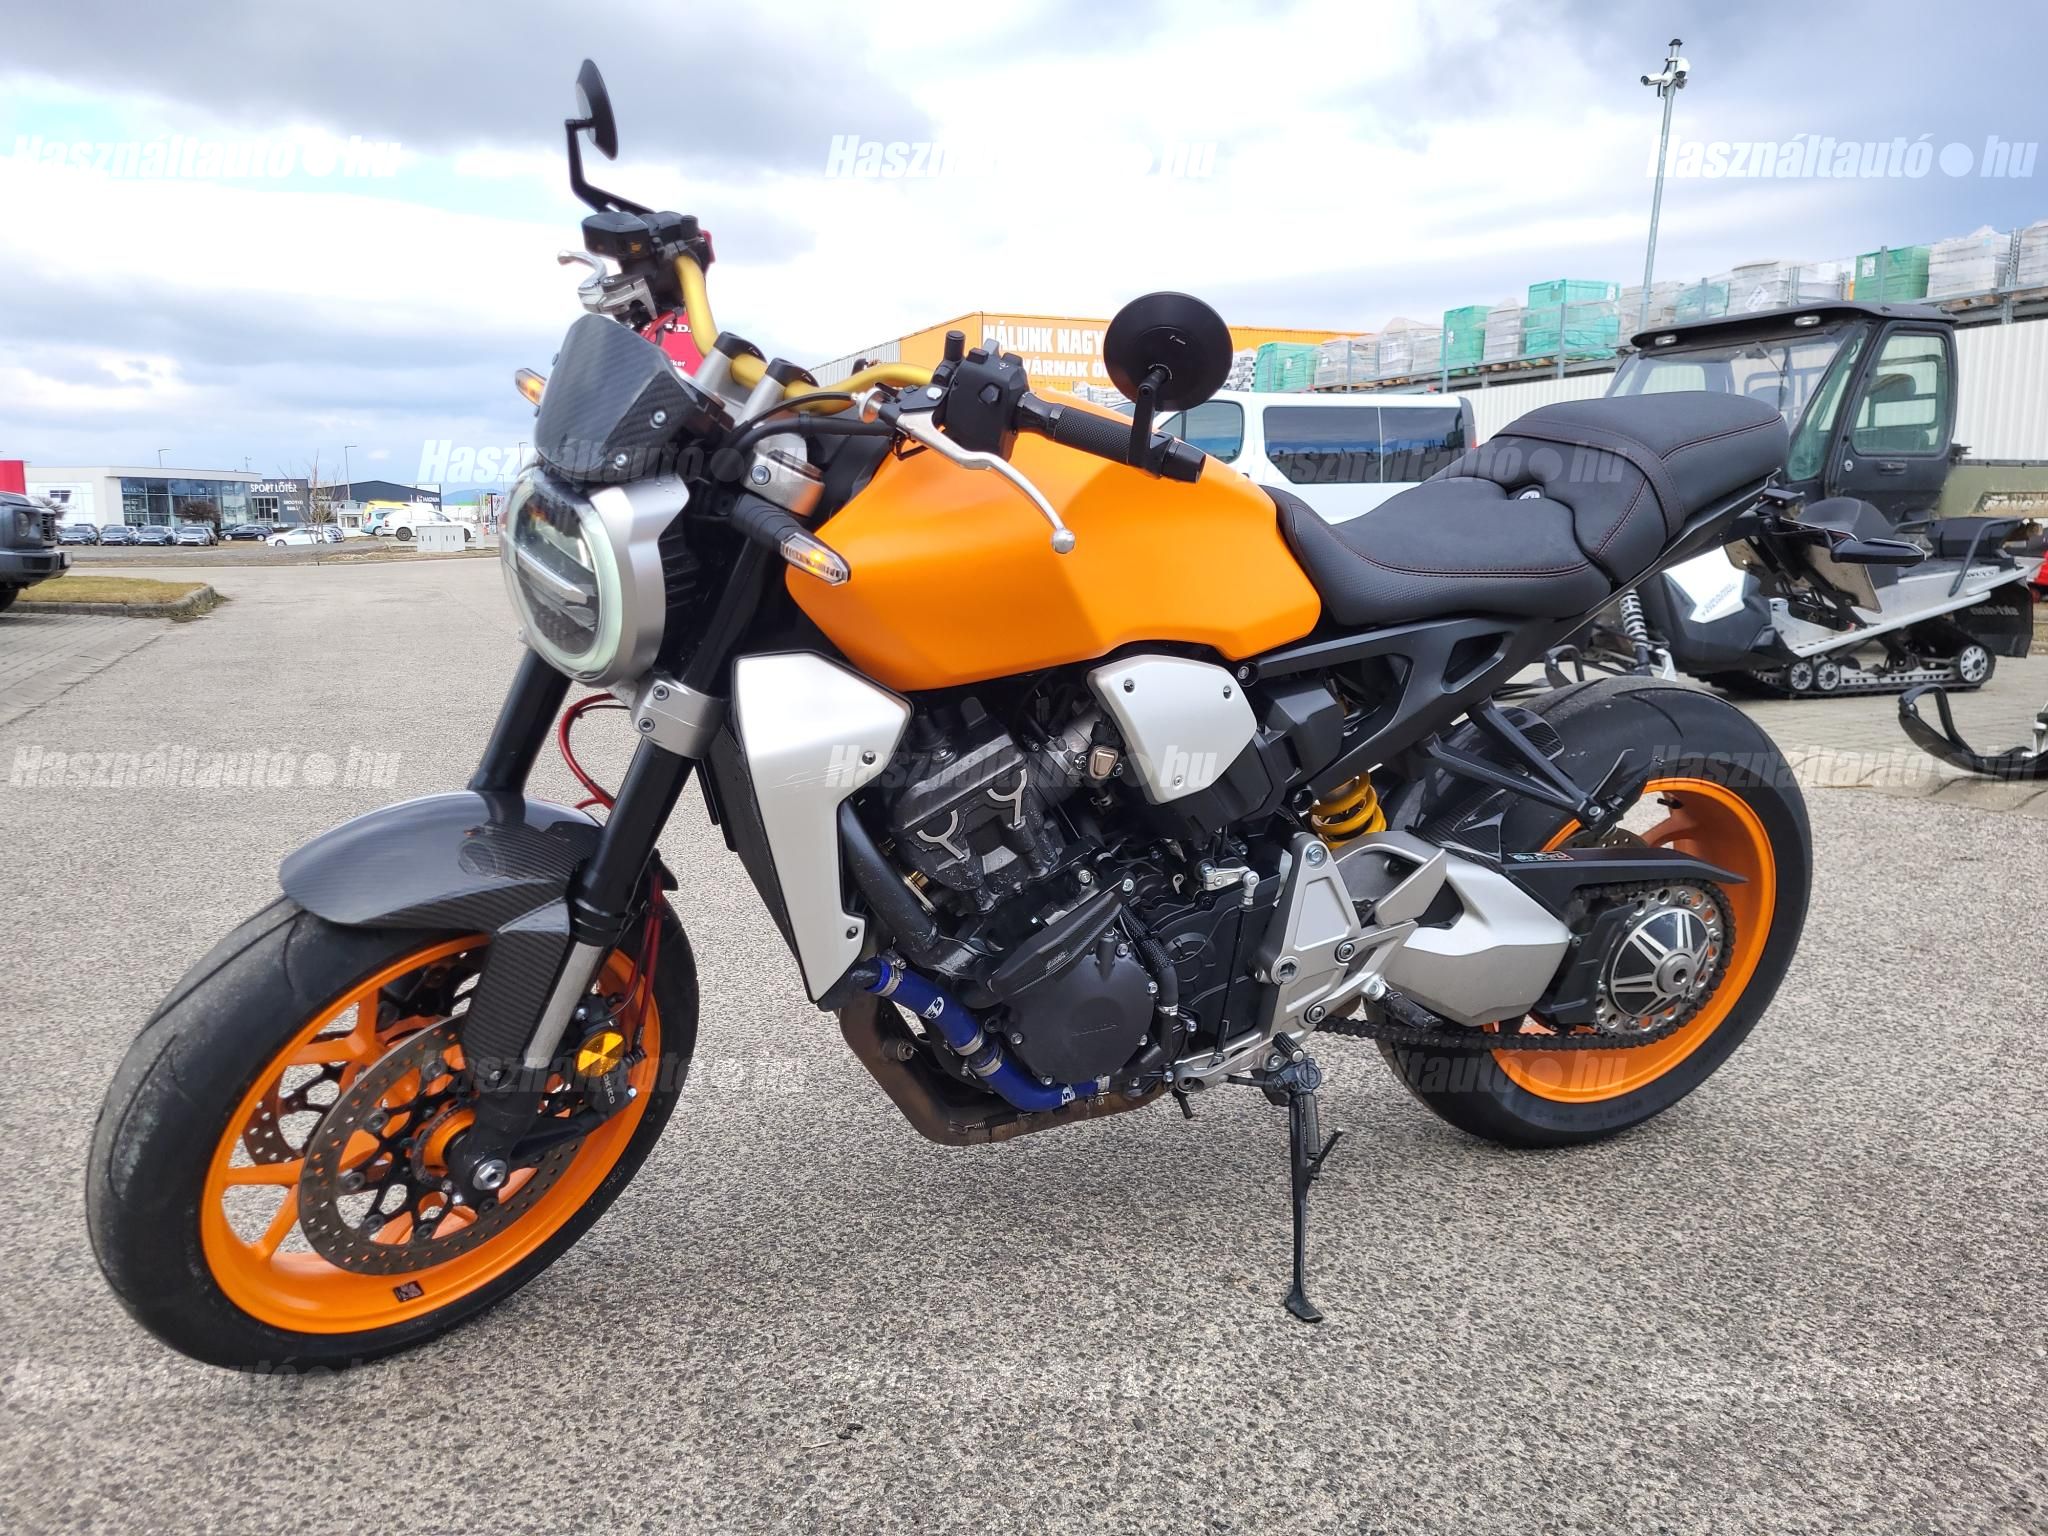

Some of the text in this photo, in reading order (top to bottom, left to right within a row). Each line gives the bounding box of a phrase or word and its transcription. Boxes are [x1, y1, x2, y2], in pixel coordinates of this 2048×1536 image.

[983, 320, 1054, 353] NÁLUNK
[1023, 356, 1089, 378] VÁRNAK
[250, 484, 274, 493] SPORT
[602, 1073, 616, 1105] OKICO
